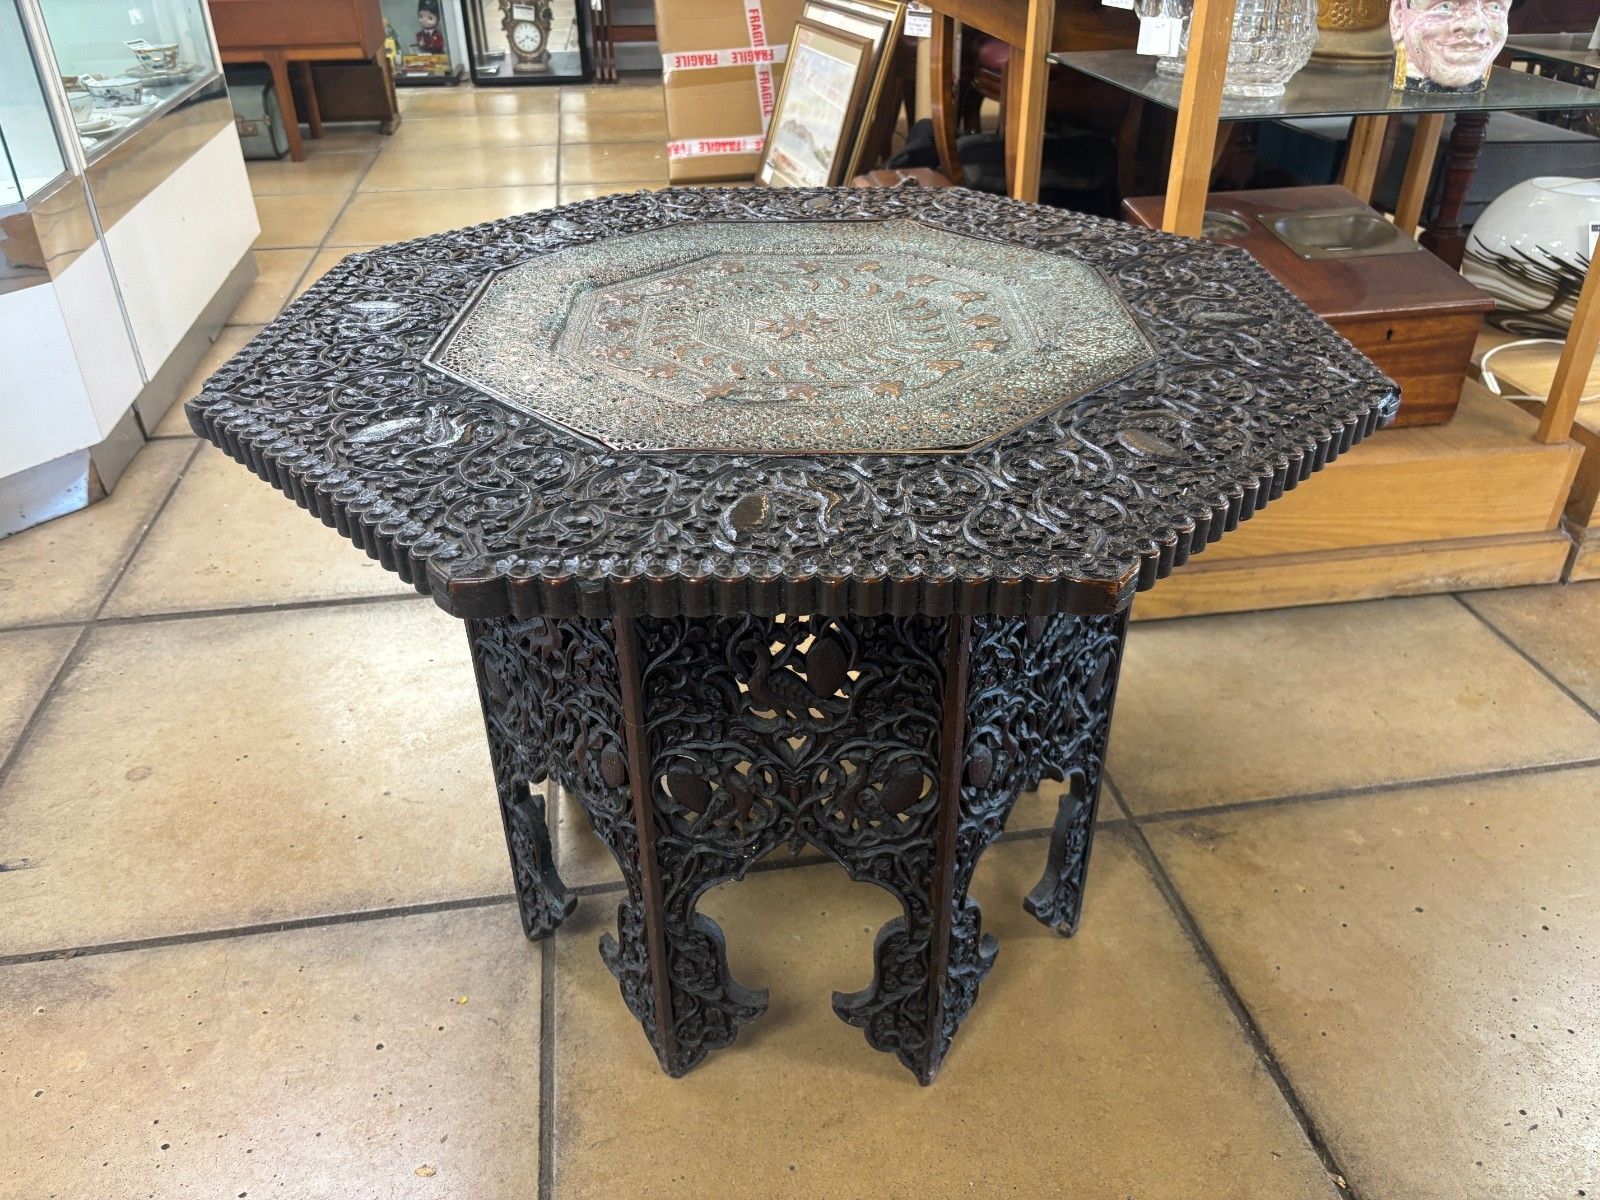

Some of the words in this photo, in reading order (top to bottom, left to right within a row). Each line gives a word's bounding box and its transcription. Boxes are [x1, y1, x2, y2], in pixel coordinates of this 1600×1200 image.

[748, 8, 765, 48] FRAGIL
[675, 53, 718, 68] FRAGILE
[731, 49, 775, 64] FRAGILE
[758, 70, 773, 117] FRAGILE
[698, 140, 742, 153] FRAGILE
